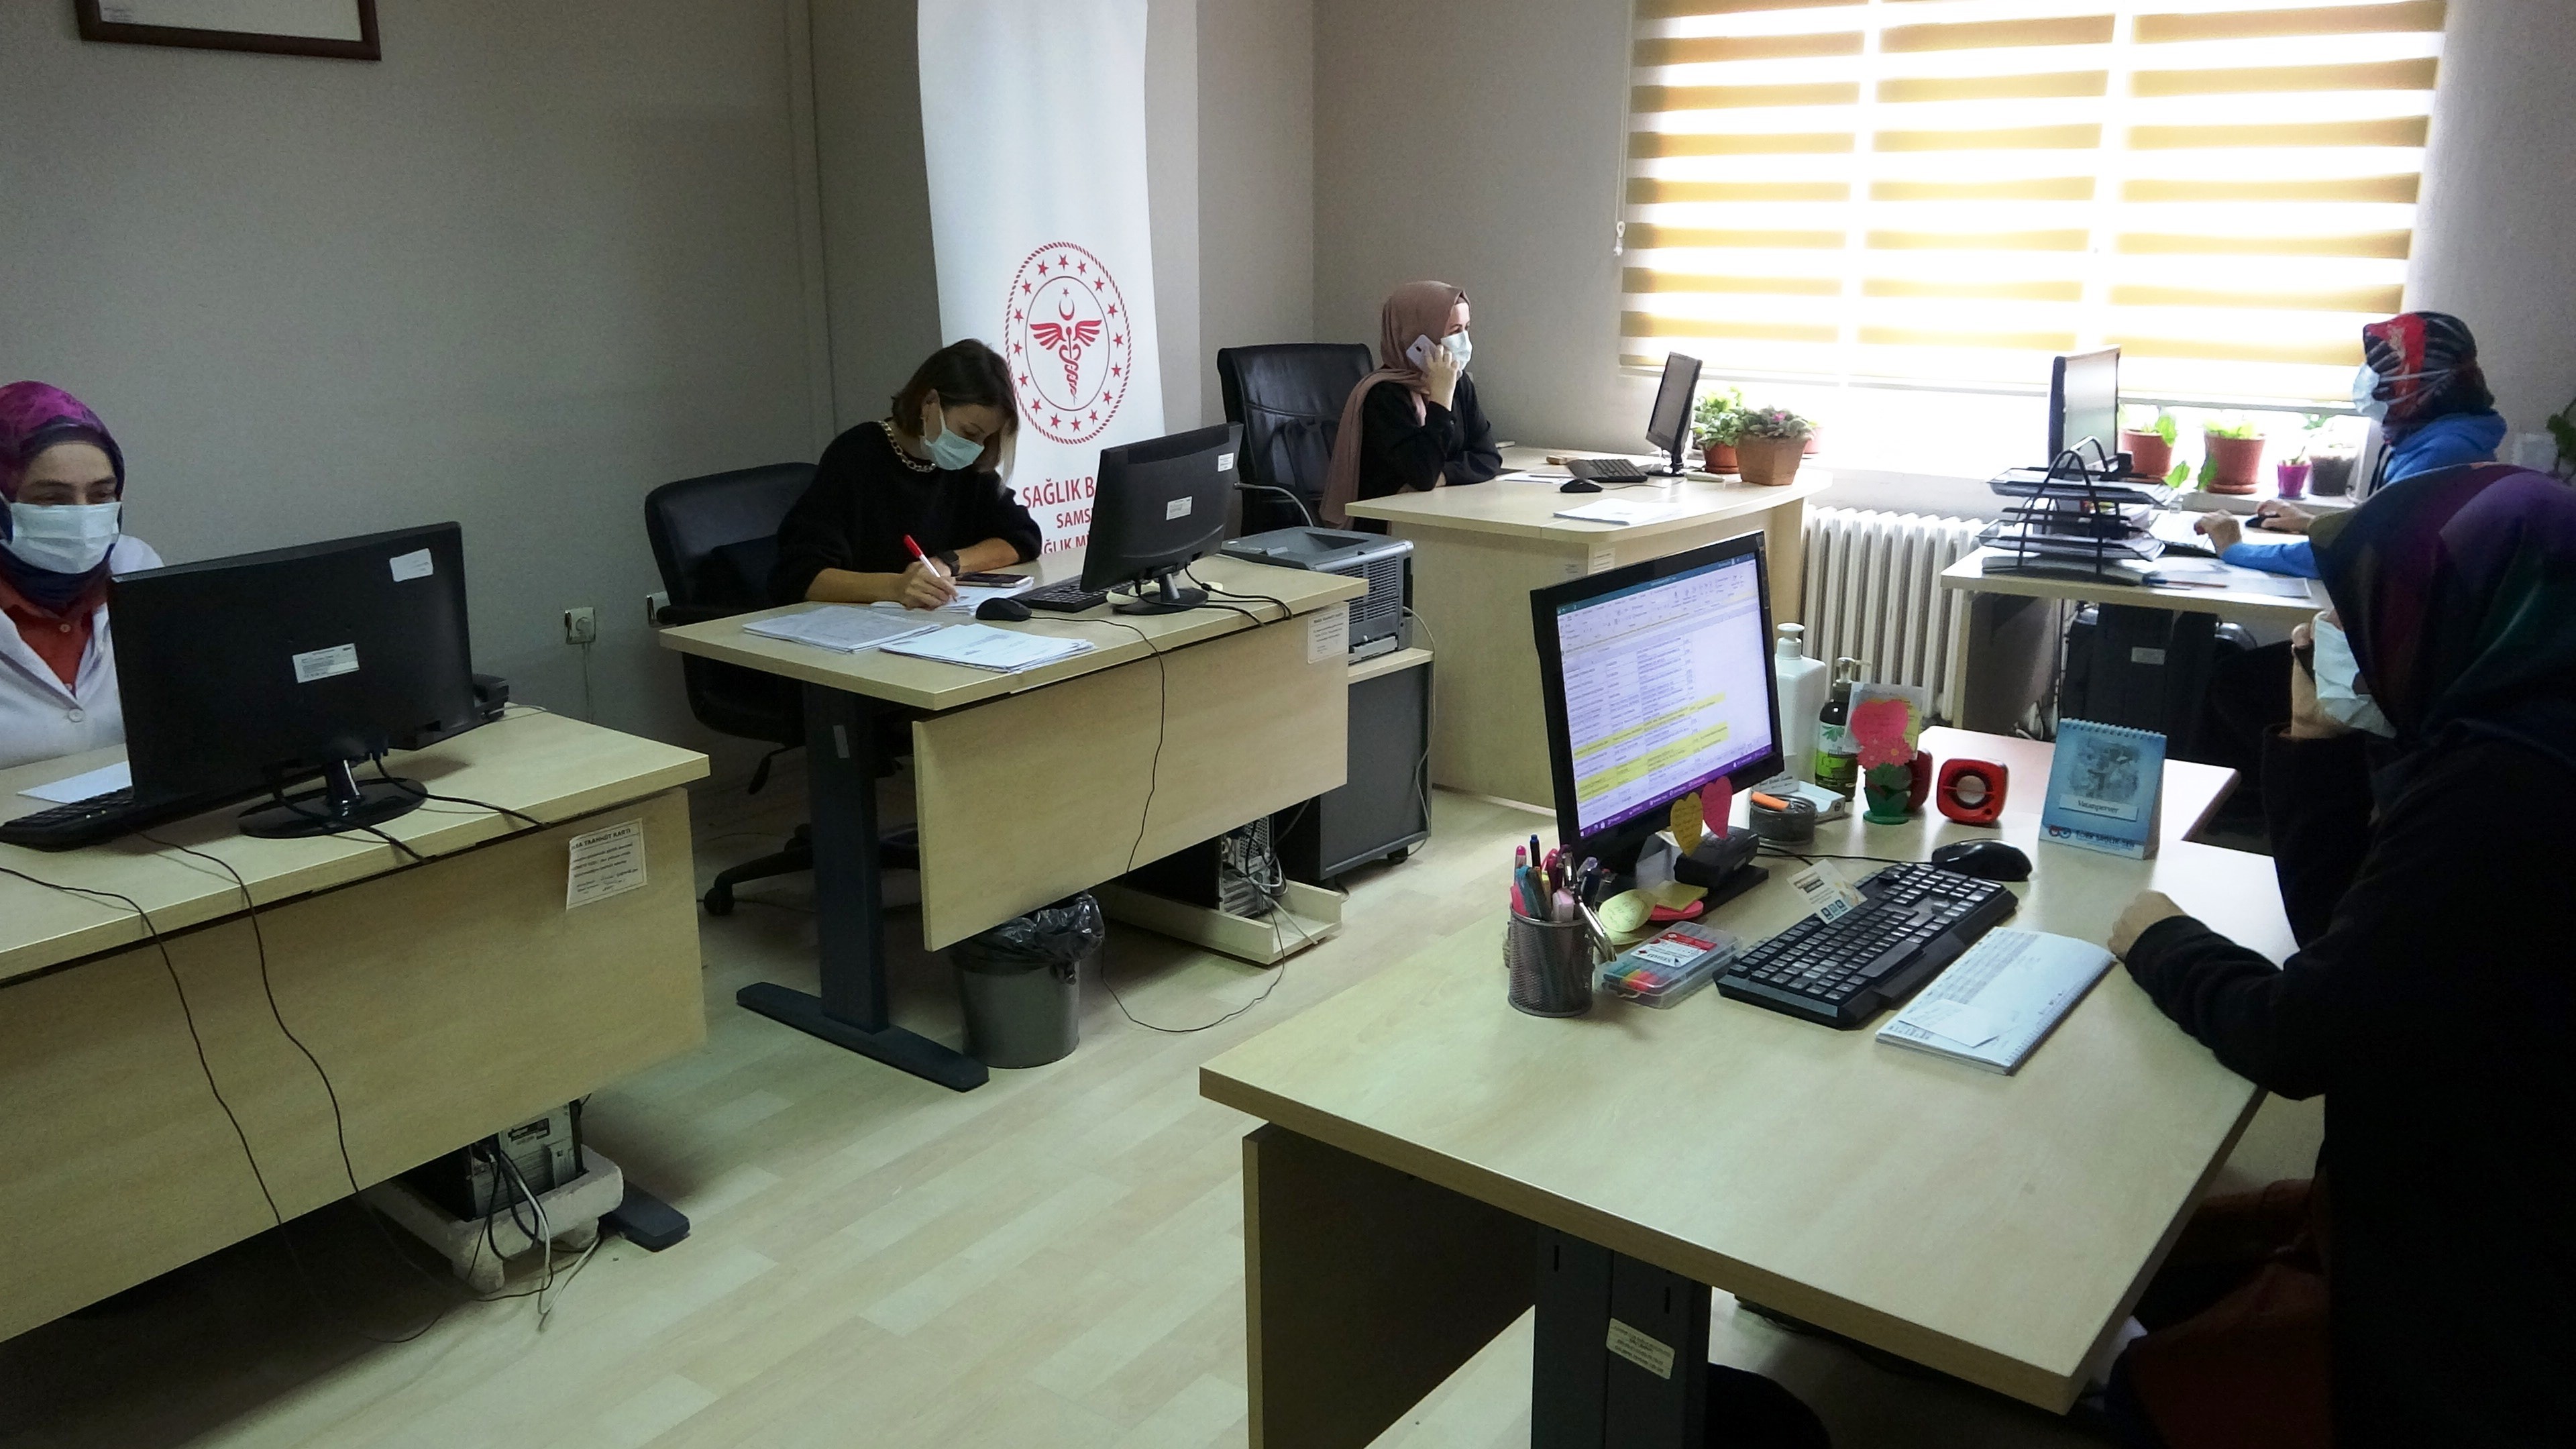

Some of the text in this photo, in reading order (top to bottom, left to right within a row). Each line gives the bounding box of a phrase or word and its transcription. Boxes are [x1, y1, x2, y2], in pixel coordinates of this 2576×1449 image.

[1022, 476, 1095, 510] SAĞLIK B
[1056, 508, 1093, 529] SAMS
